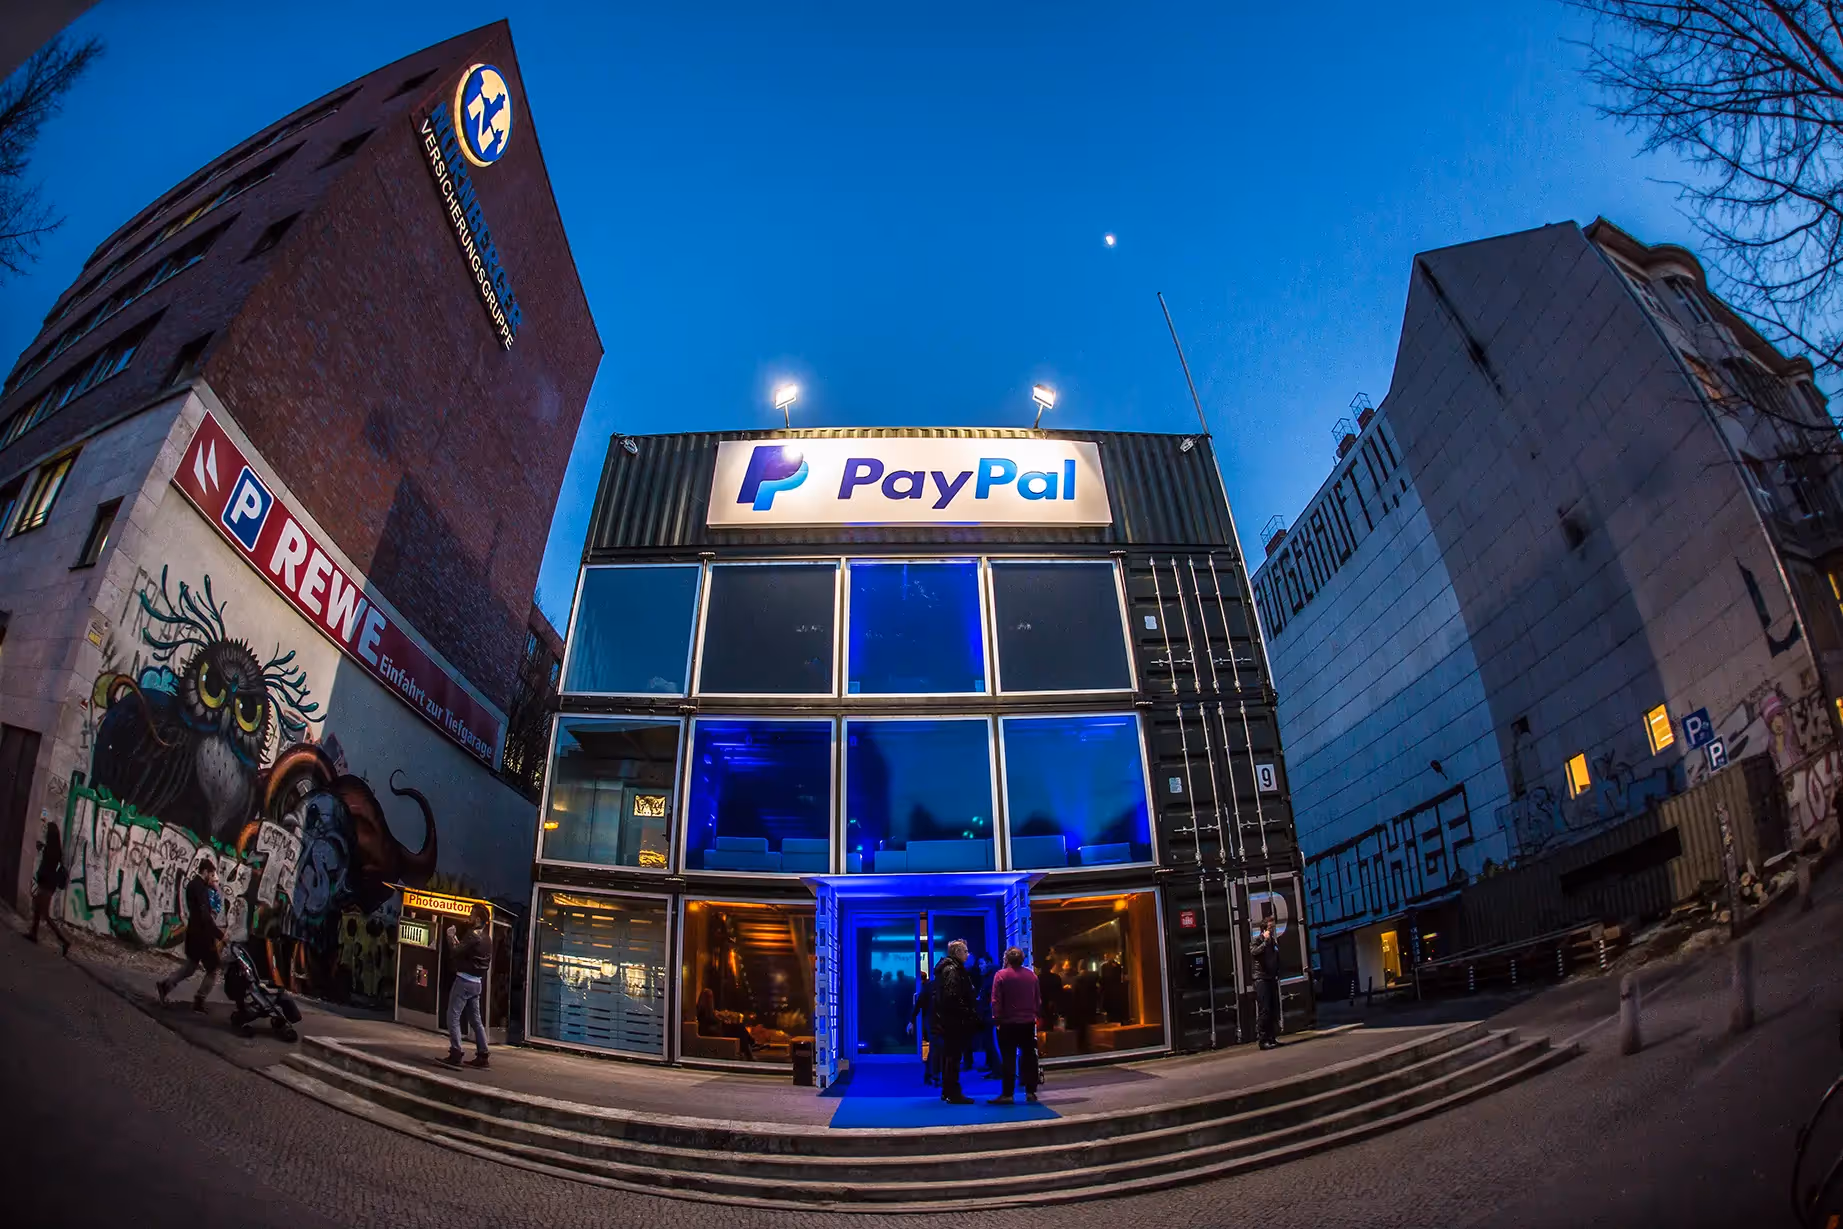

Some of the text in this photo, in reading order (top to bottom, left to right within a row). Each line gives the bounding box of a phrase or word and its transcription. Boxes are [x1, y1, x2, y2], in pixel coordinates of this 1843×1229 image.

[421, 118, 514, 351] VERSICHERUNGSGRUPPE
[838, 457, 1076, 510] PayPal
[230, 480, 386, 668] P REWE
[379, 653, 492, 759] Einfahrt zur Tiefgarage
[1685, 716, 1702, 745] P
[1709, 741, 1724, 767] P
[1261, 767, 1273, 788] 9
[409, 894, 473, 913] Photoautom
